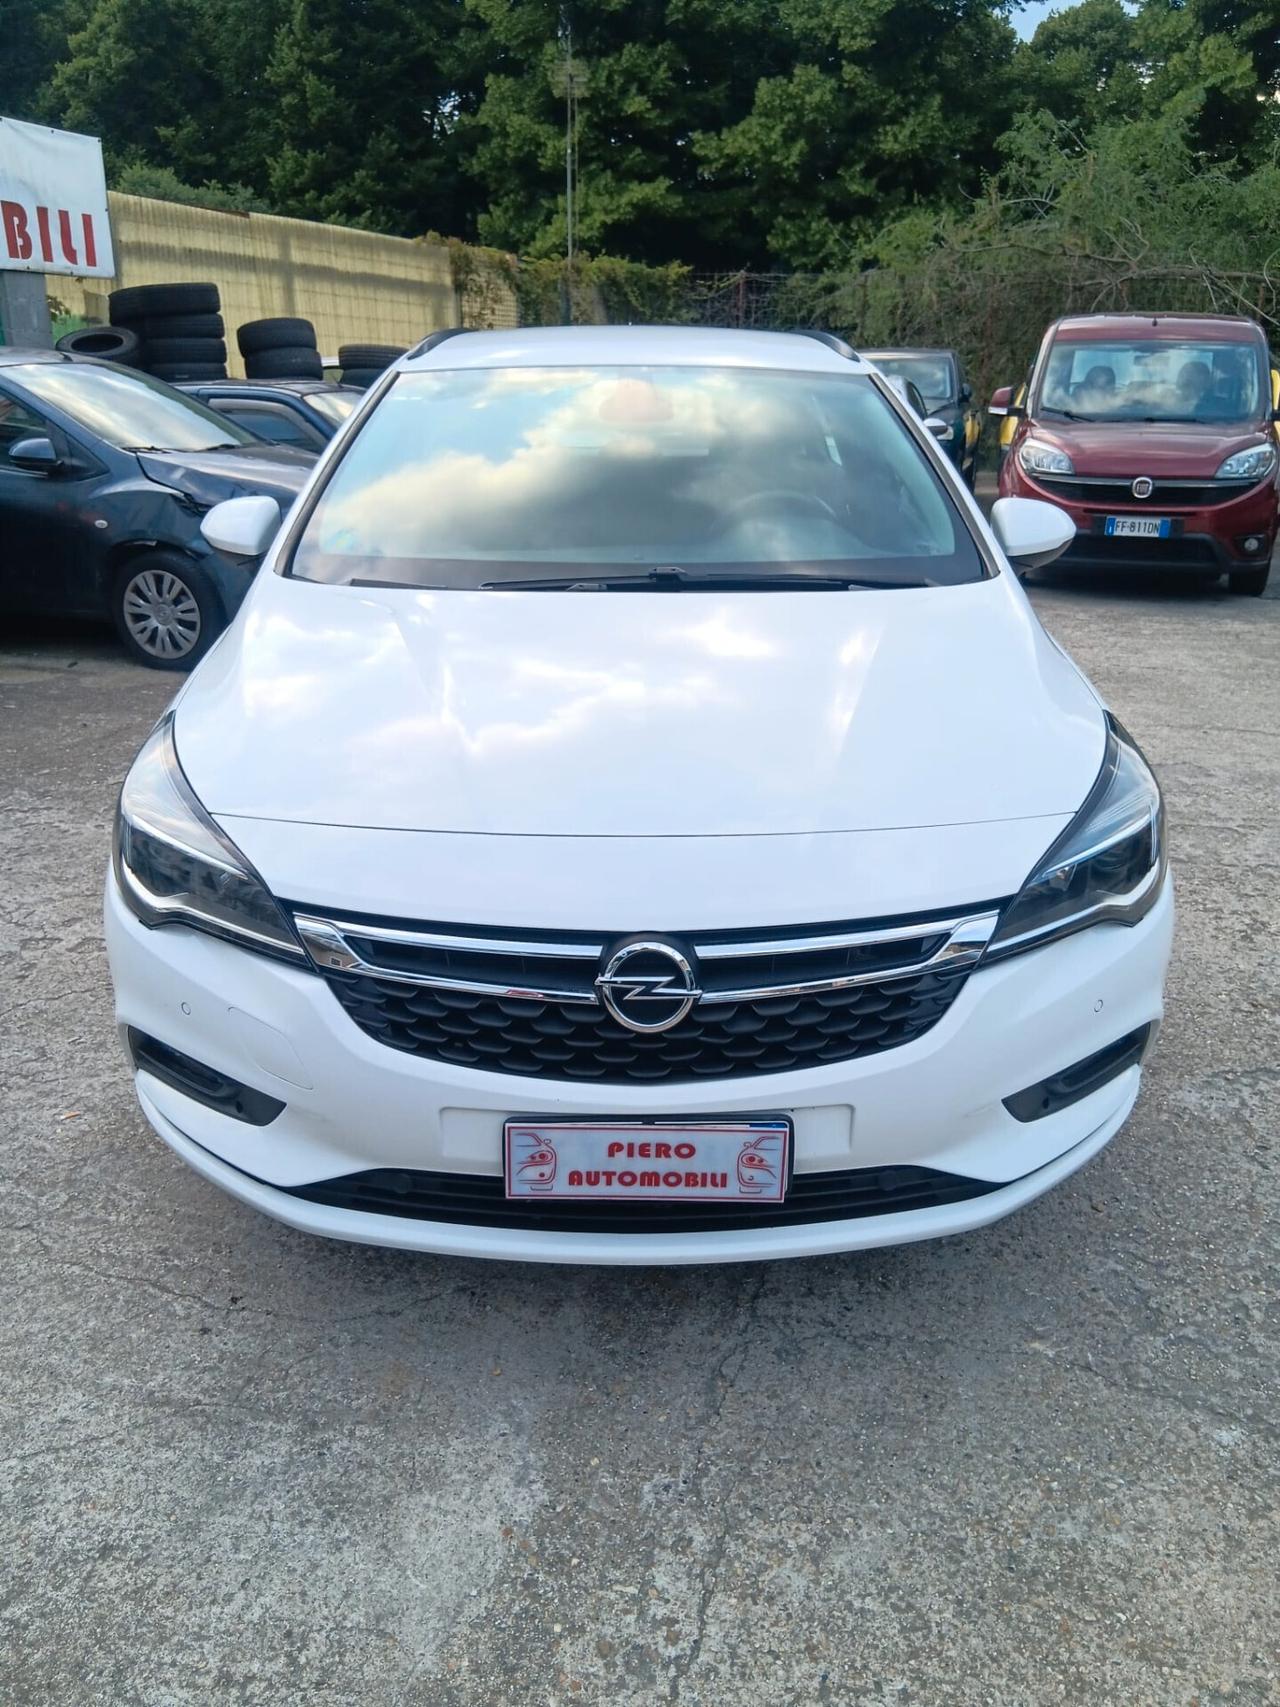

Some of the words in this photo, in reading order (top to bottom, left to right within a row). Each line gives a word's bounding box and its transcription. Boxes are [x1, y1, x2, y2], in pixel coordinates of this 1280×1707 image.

[0, 200, 97, 267] BILI
[607, 1142, 696, 1159] PIERO
[568, 1170, 728, 1188] AUTOMOBILI
